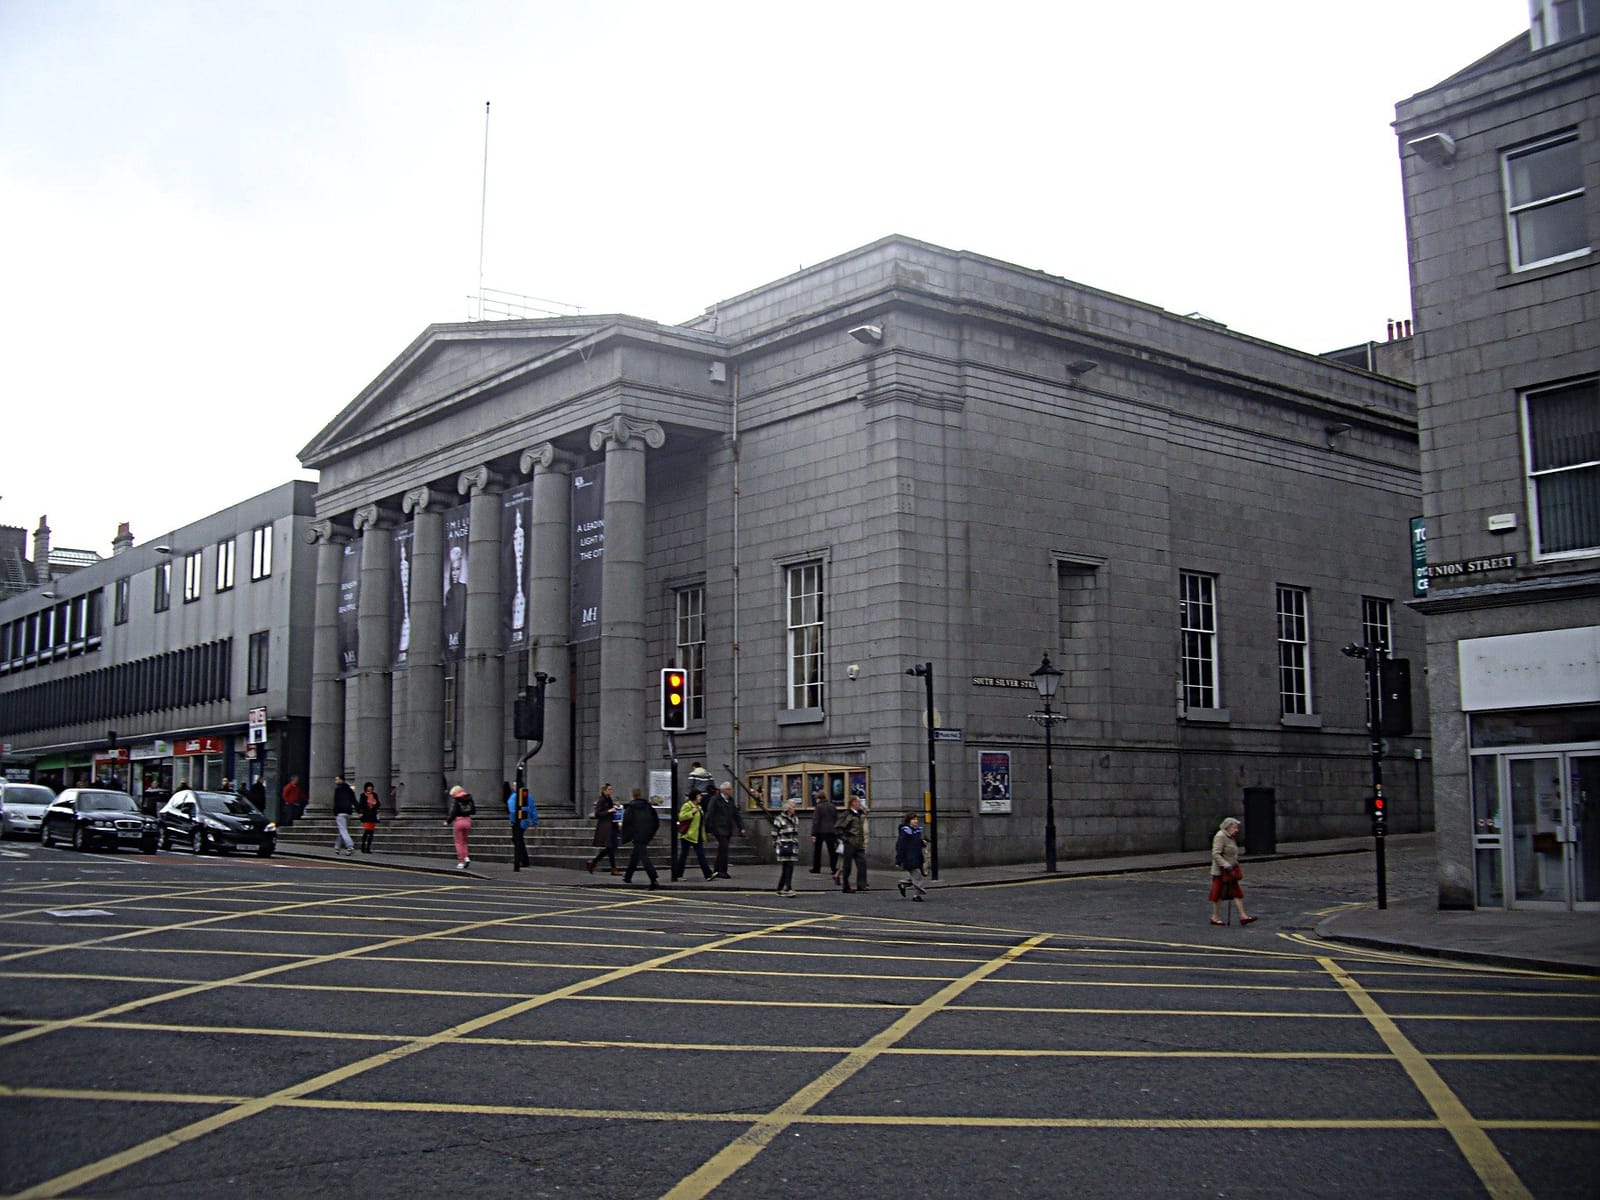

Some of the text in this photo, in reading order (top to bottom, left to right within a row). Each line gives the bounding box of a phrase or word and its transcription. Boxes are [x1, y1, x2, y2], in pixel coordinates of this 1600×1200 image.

[1428, 563, 1463, 576] UNION
[1467, 556, 1513, 572] STREET
[972, 677, 1037, 689] SOUTH SILVER STRE
